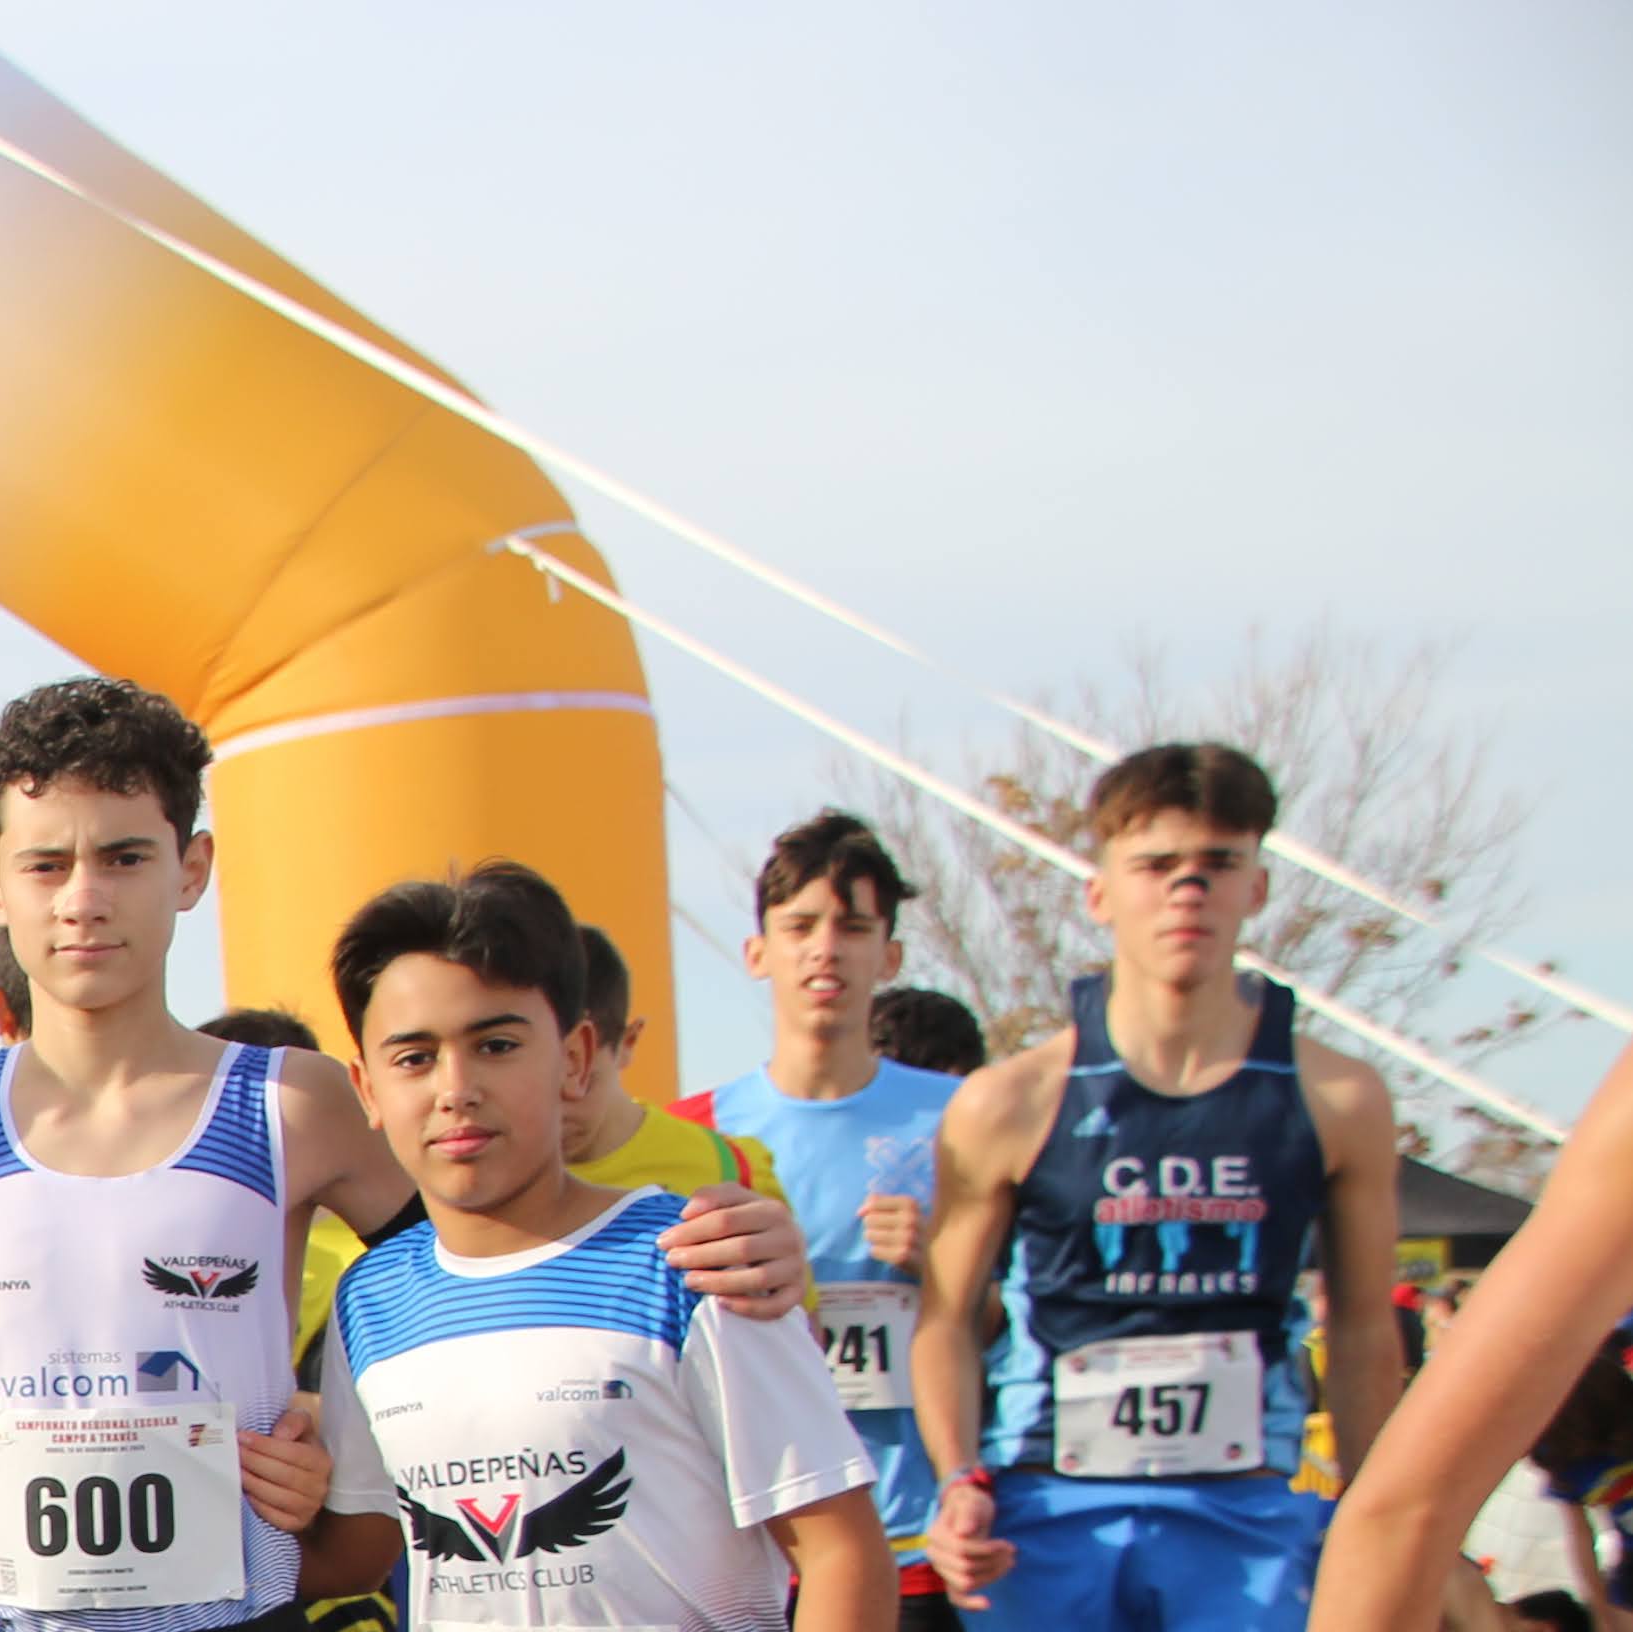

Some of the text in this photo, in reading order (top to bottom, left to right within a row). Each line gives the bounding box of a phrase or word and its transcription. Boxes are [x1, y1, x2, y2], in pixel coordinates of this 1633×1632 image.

[161, 1255, 247, 1269] VALDEPEÑAS
[163, 1300, 215, 1311] ATHLETICS
[49, 1349, 121, 1365] sistemas
[0, 1366, 128, 1398] valcom
[536, 1385, 599, 1402] valcom
[1112, 1383, 1211, 1436] 457
[402, 1448, 587, 1492] VALDEPEÑAS
[25, 1472, 175, 1557] 600
[429, 1564, 594, 1594] ATHLETICS CLUB
